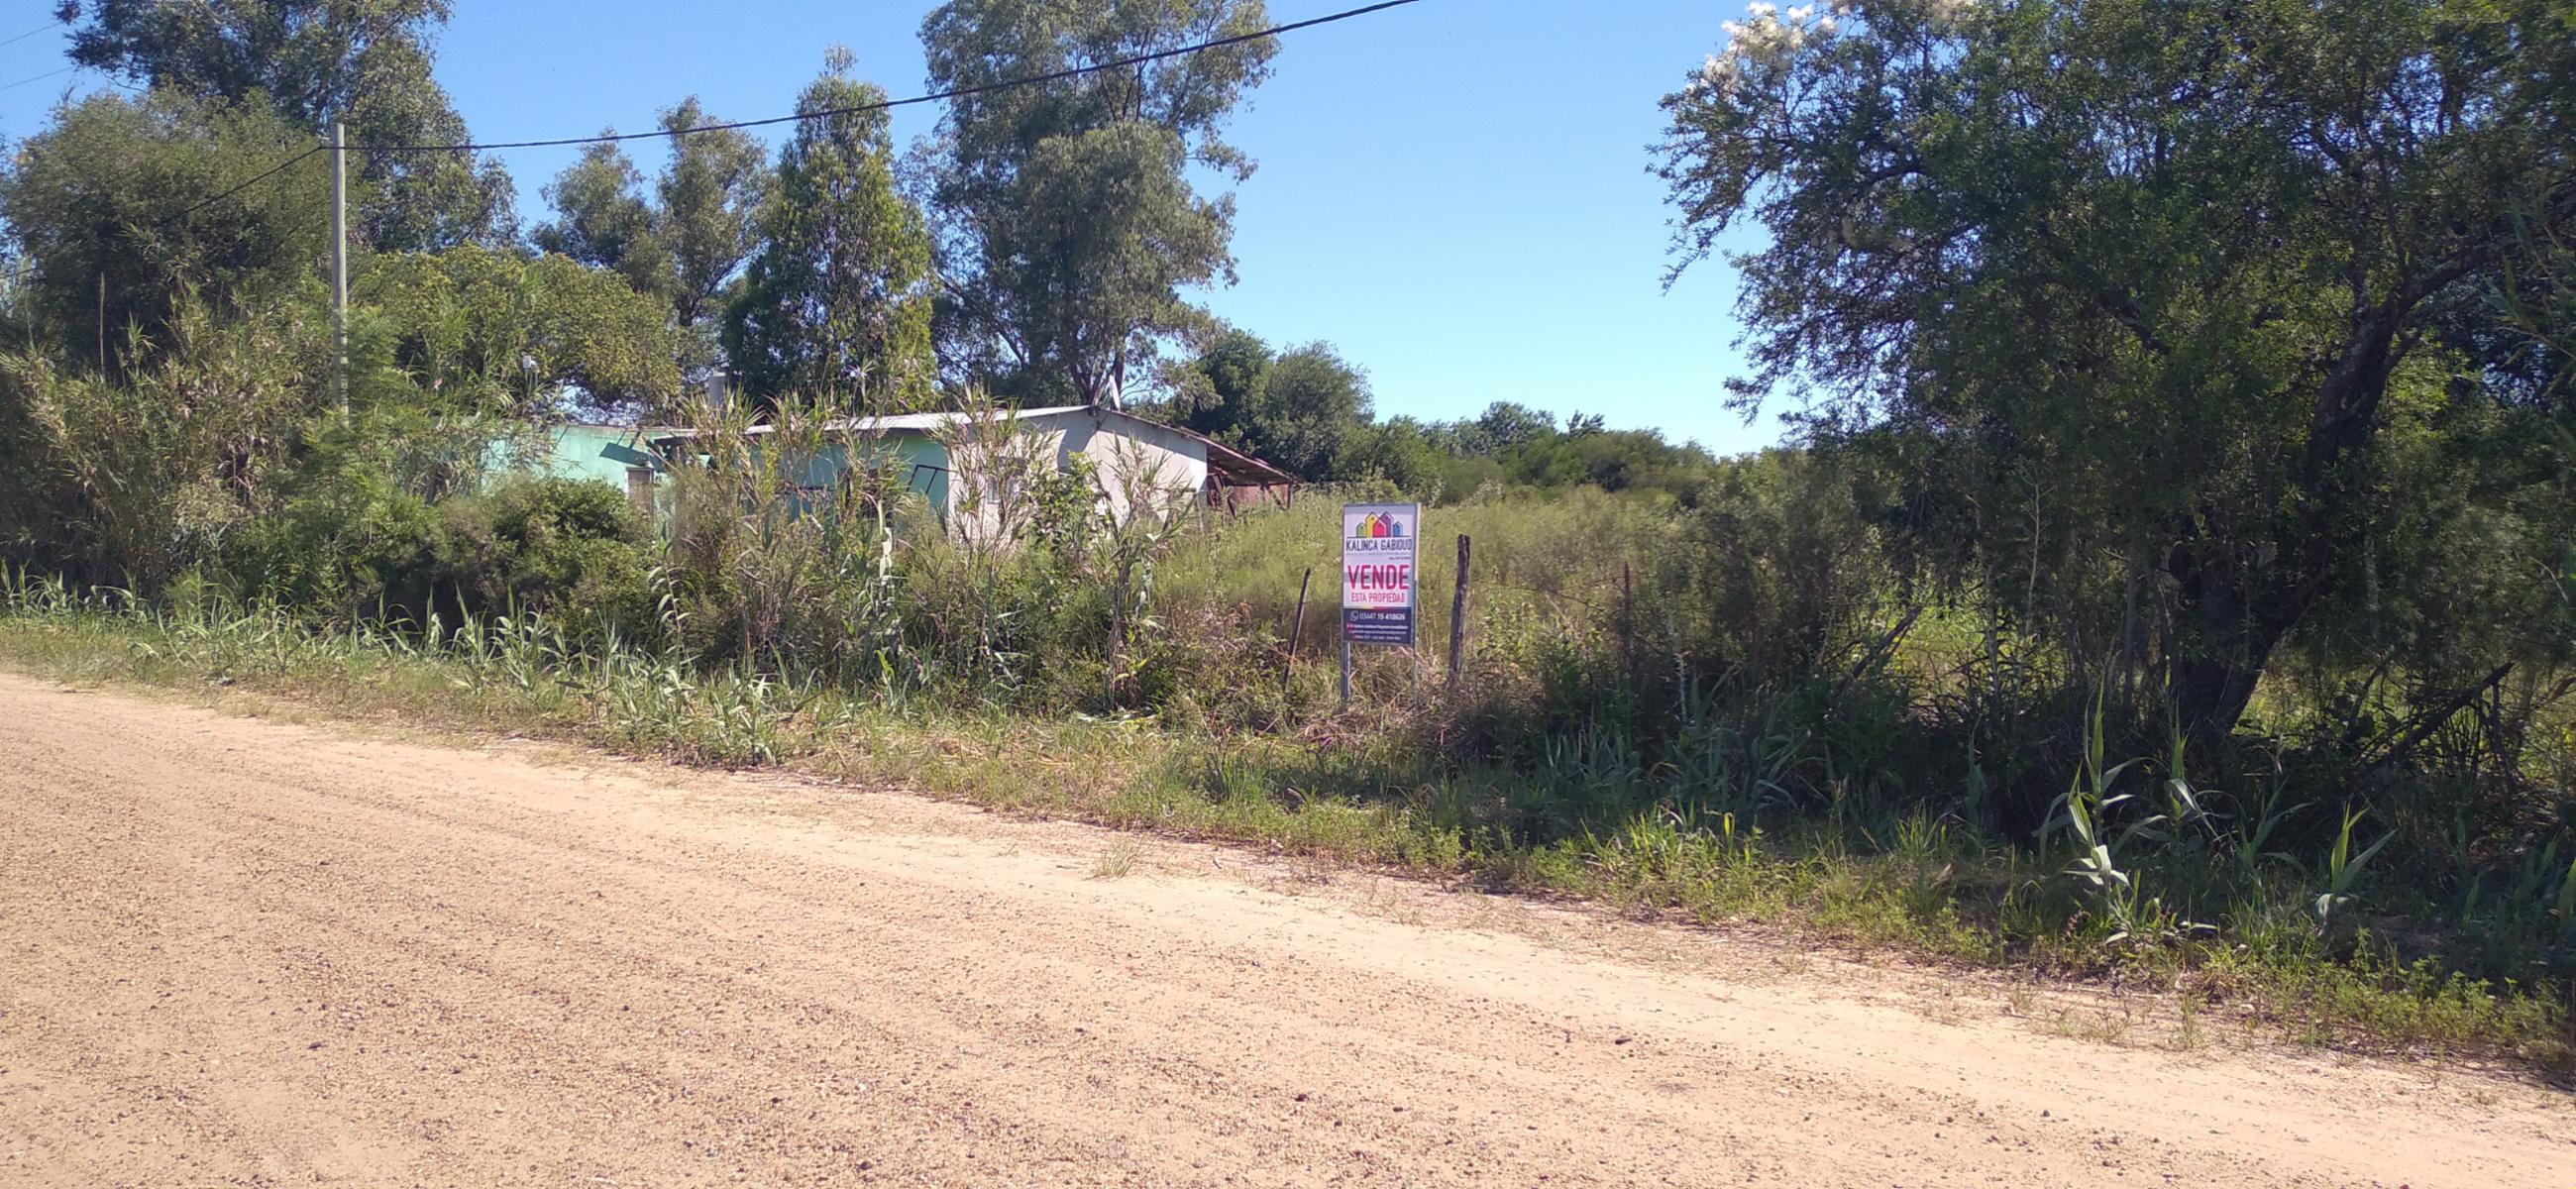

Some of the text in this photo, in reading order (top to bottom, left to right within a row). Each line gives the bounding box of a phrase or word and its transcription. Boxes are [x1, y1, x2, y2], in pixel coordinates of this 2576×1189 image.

[1346, 539, 1412, 551] KALINCA GABIOUD
[1347, 564, 1410, 590] VENDE
[1351, 593, 1406, 602] ESTA PROPIEDAD
